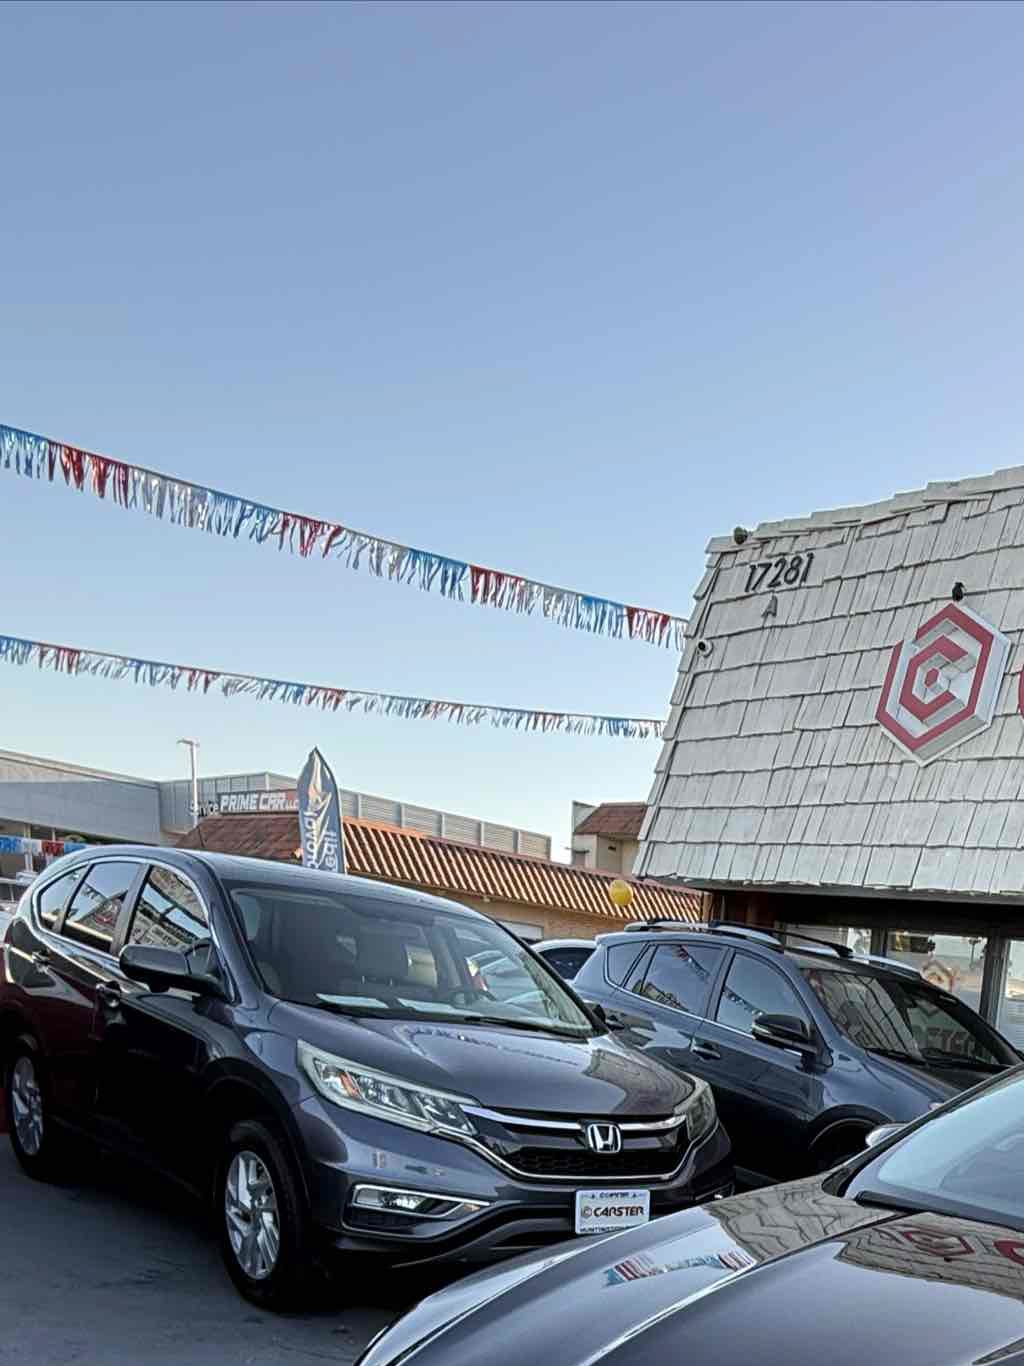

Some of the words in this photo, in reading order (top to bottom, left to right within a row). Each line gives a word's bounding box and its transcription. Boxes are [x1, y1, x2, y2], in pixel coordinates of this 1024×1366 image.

[744, 552, 814, 593] 17281
[761, 595, 778, 618] A
[220, 793, 258, 811] PRIME
[259, 791, 286, 810] CAR
[593, 1206, 645, 1218] CARSTER
